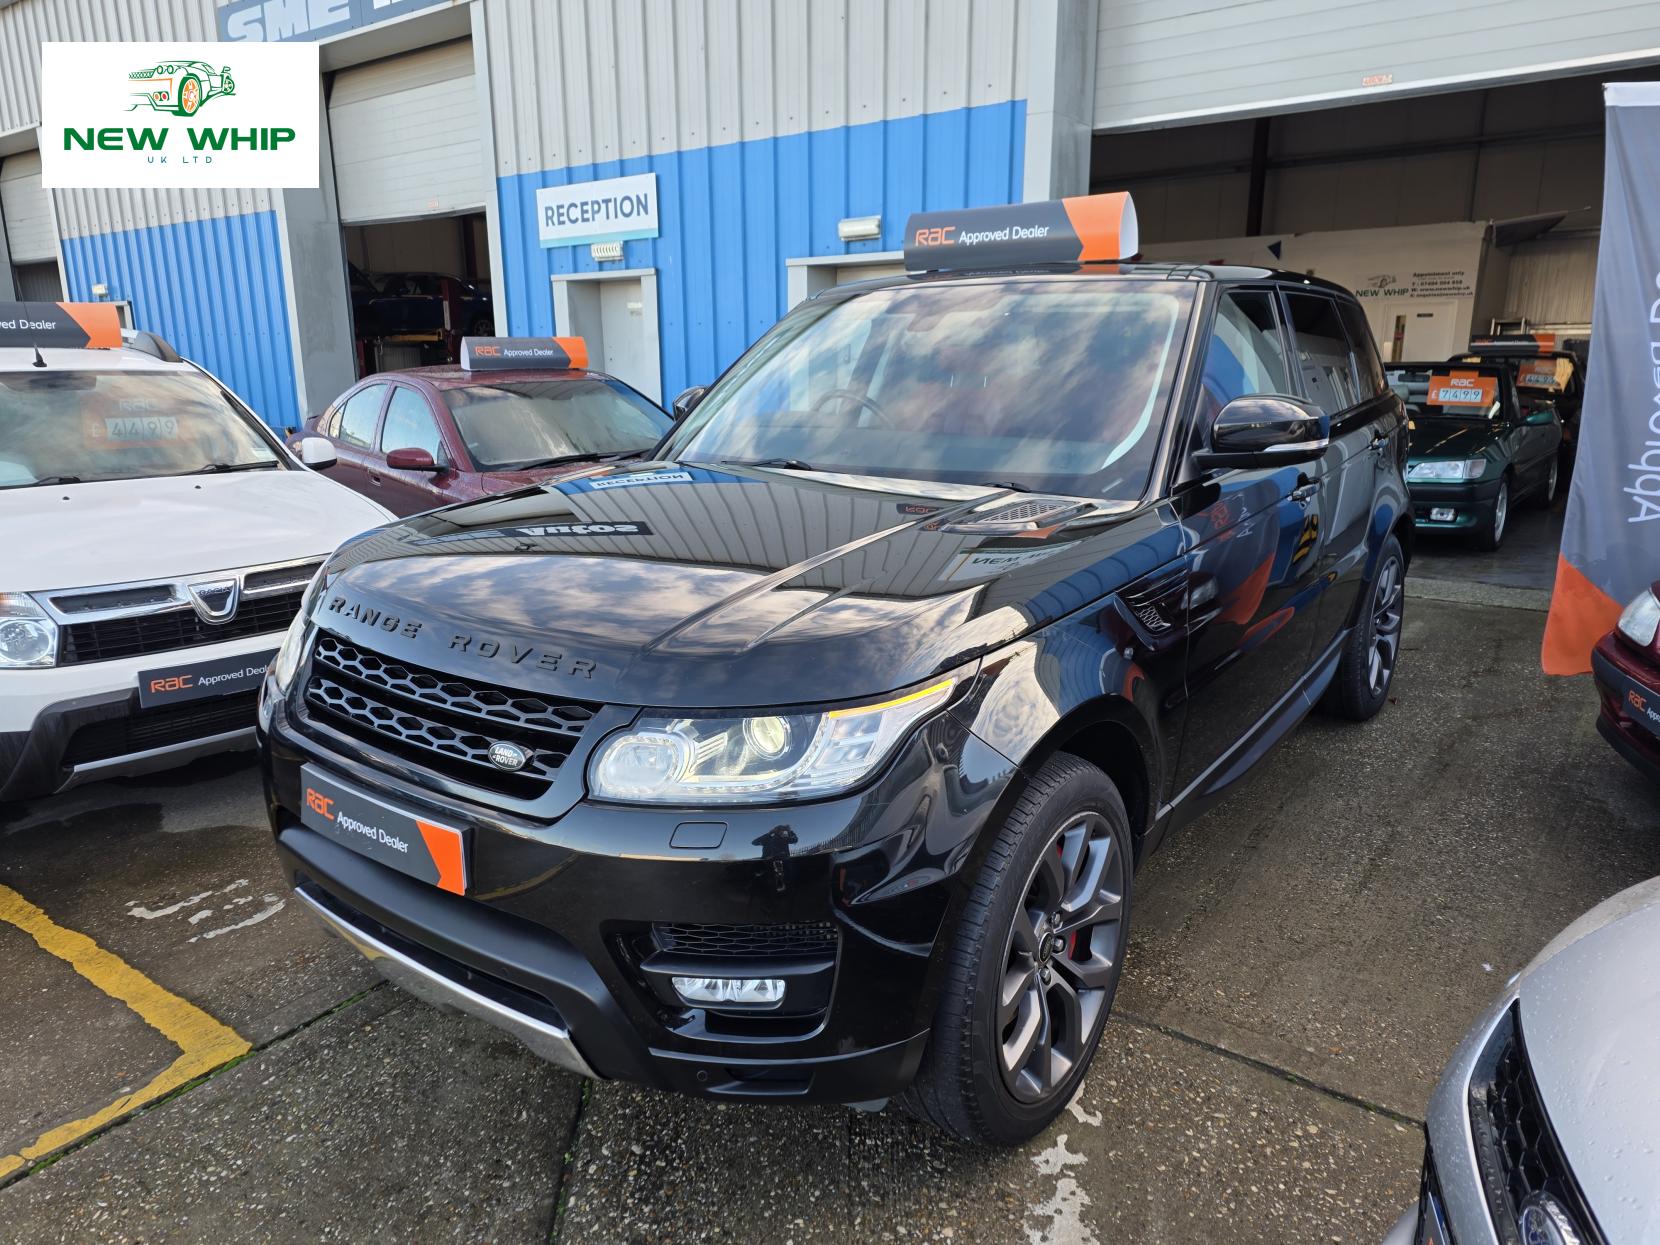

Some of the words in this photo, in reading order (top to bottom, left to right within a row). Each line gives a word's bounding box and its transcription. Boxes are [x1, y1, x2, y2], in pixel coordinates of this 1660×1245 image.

[544, 193, 649, 227] RECEPTION
[959, 227, 1010, 246] Approved
[1012, 224, 1050, 240] Dealer
[1355, 288, 1380, 297] NEW
[1384, 287, 1409, 297] WHIP
[19, 319, 56, 330] Dealer
[503, 348, 533, 356] Approved
[1442, 389, 1480, 400] 7499
[111, 421, 176, 437] 4499
[328, 596, 423, 640] RANGE
[448, 631, 598, 680] ROVER
[198, 669, 244, 686] Approved
[246, 664, 267, 676] Deal
[494, 747, 513, 757] LAND
[495, 755, 518, 767] ROVER
[336, 811, 377, 840] Approved
[378, 829, 409, 854] Dealer
